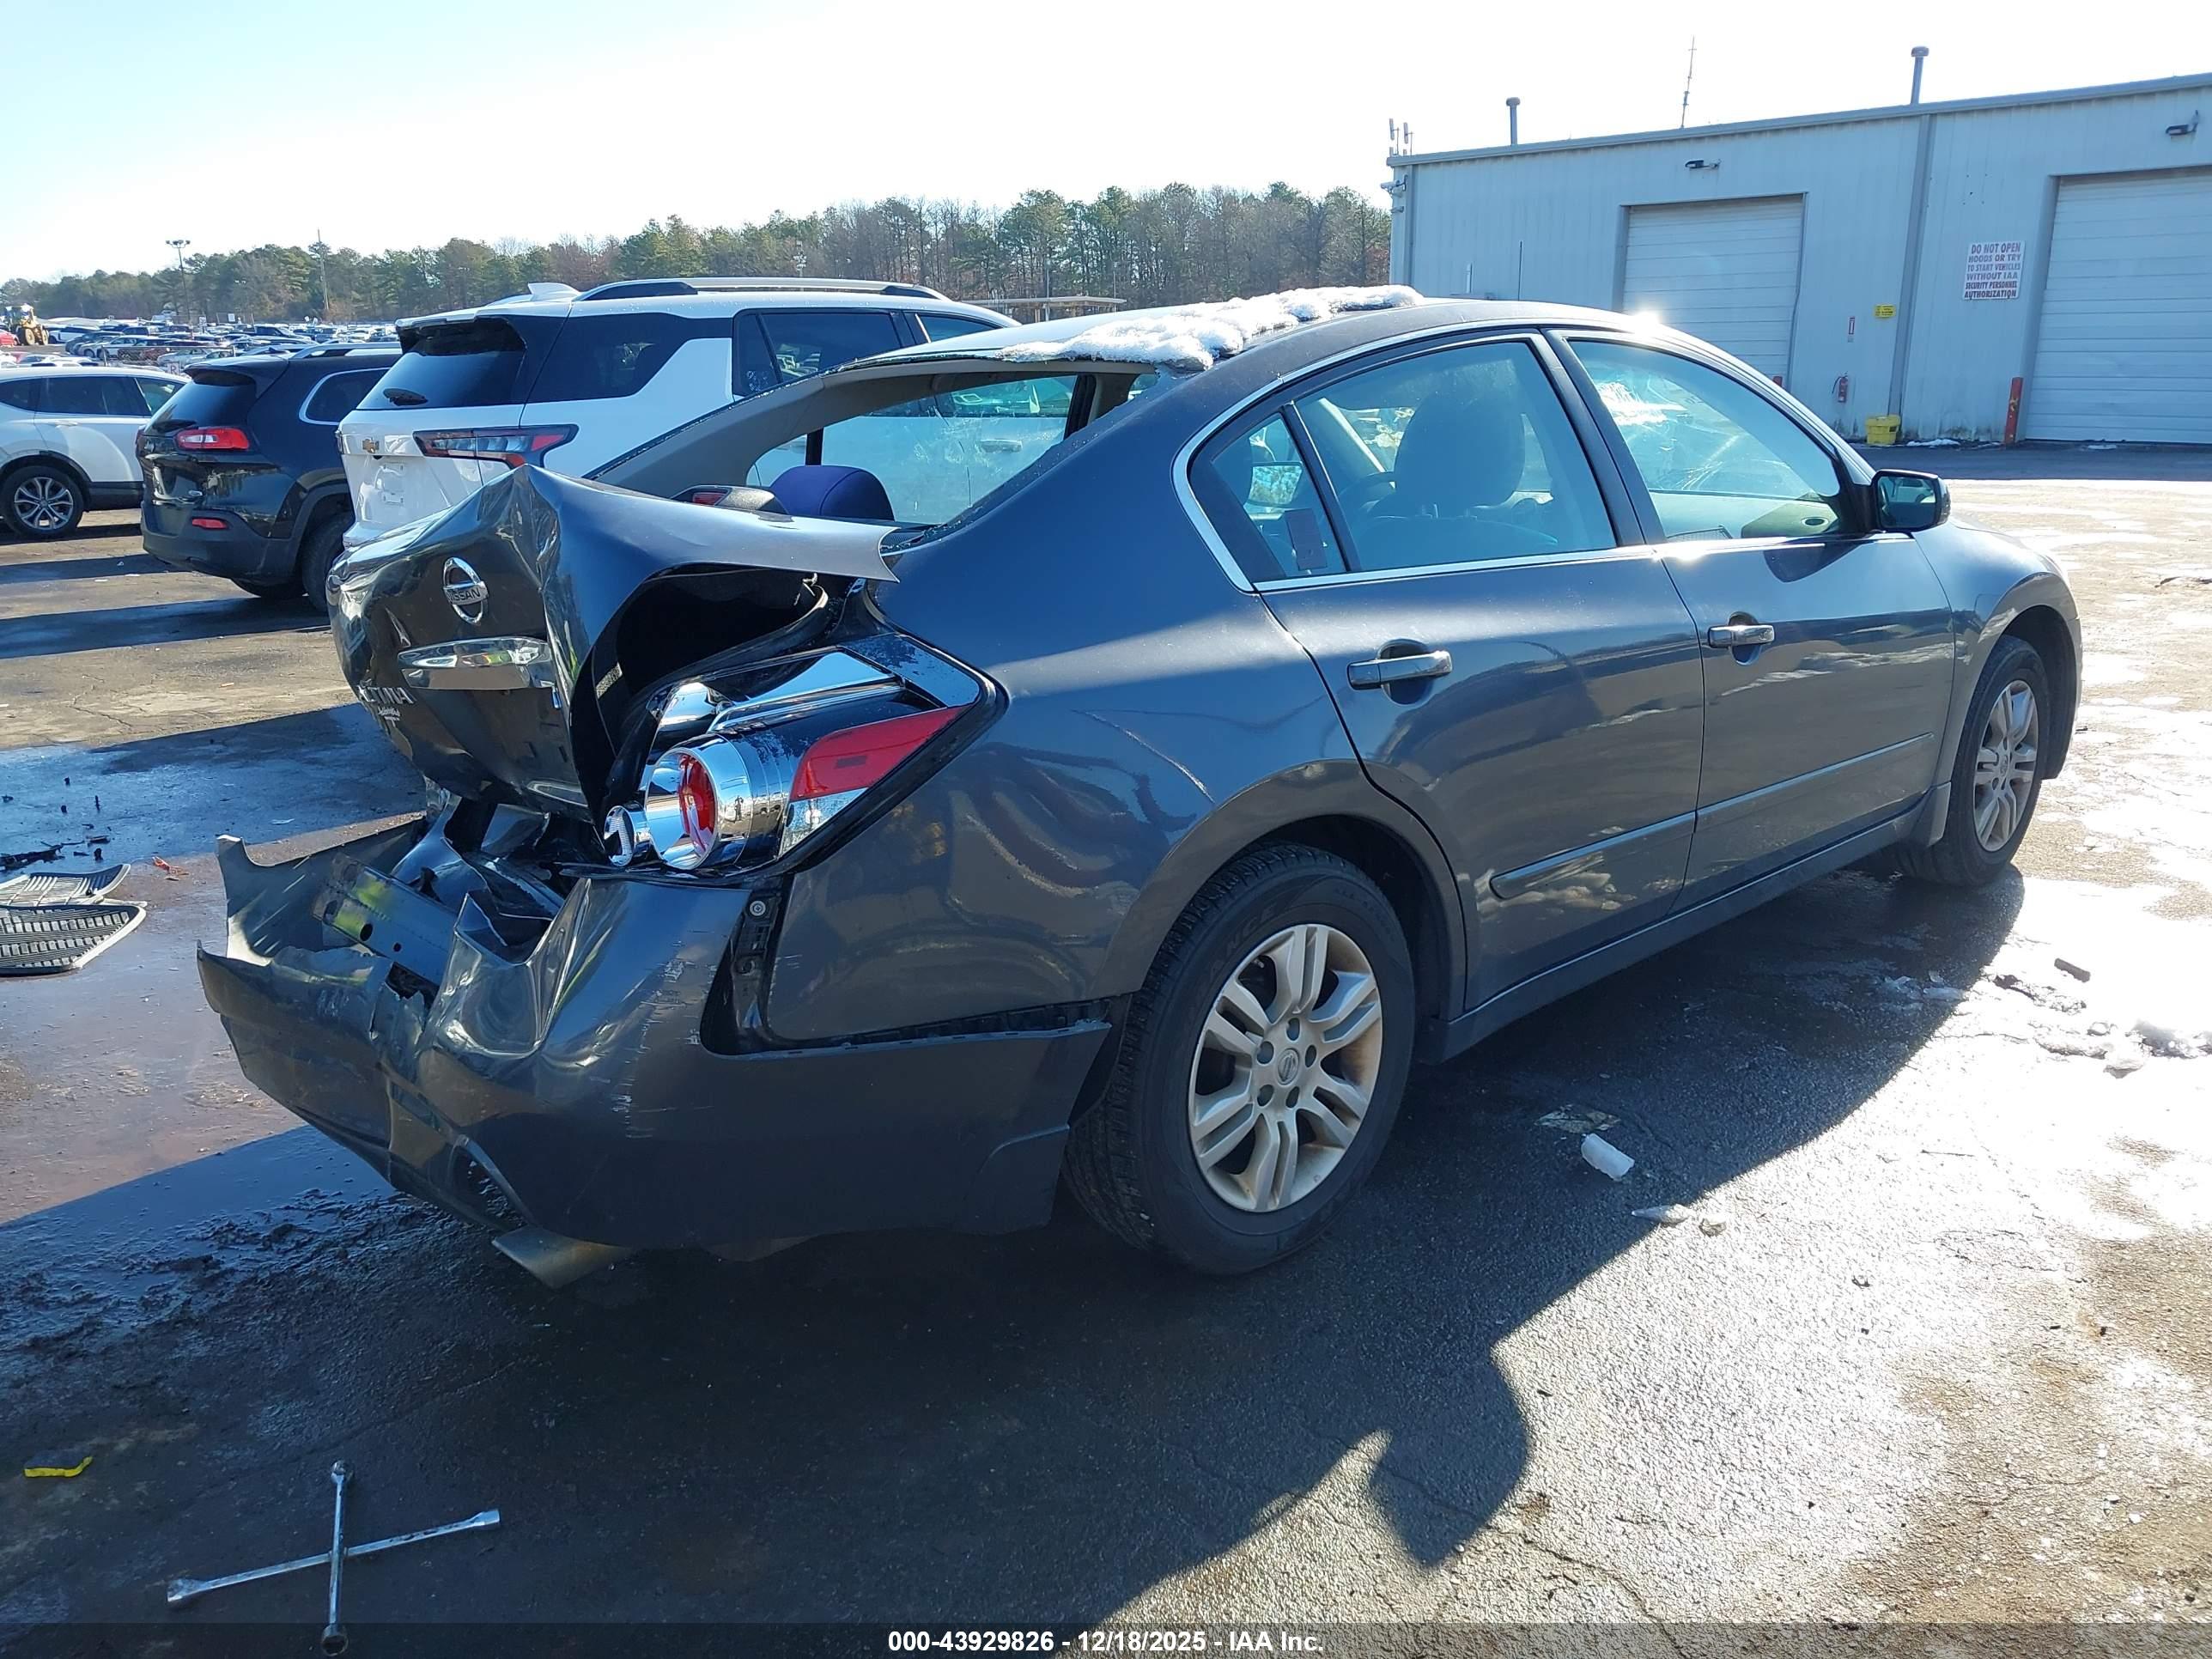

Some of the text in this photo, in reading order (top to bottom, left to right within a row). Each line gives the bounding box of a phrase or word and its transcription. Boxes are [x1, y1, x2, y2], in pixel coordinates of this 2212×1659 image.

[1972, 242, 2021, 254] DO NOT OPEN
[1968, 264, 1975, 272] TO
[1996, 263, 2021, 271] VEHICLES
[1990, 281, 2018, 289] PERSONNEL
[1965, 290, 2017, 299] AUTHORIZATION
[446, 587, 481, 602] NISSAN
